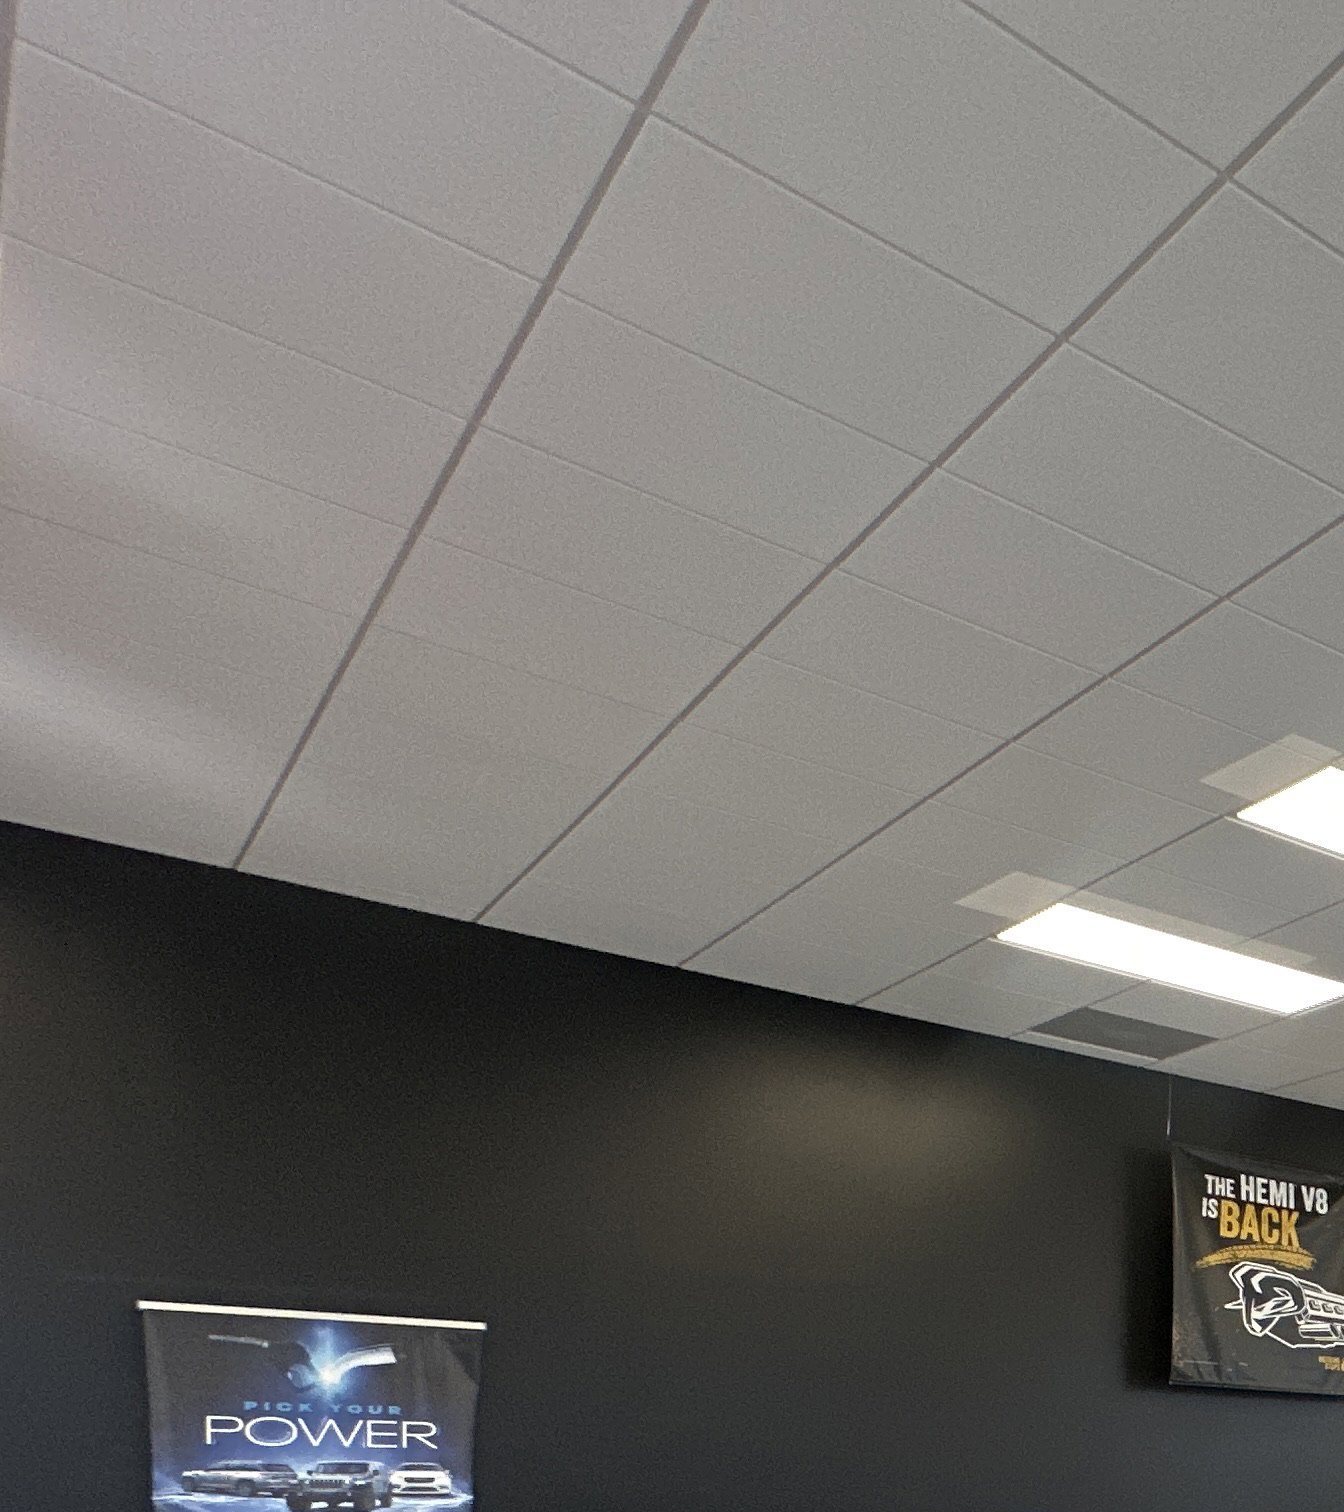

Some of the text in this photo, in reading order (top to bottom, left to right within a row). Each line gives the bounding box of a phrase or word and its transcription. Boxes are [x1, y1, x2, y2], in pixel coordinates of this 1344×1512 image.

[1204, 1173, 1329, 1215] THE HEMI V8
[1201, 1197, 1300, 1248] IS BACK
[243, 1401, 402, 1415] PICK YOUR
[205, 1415, 438, 1450] POWER
